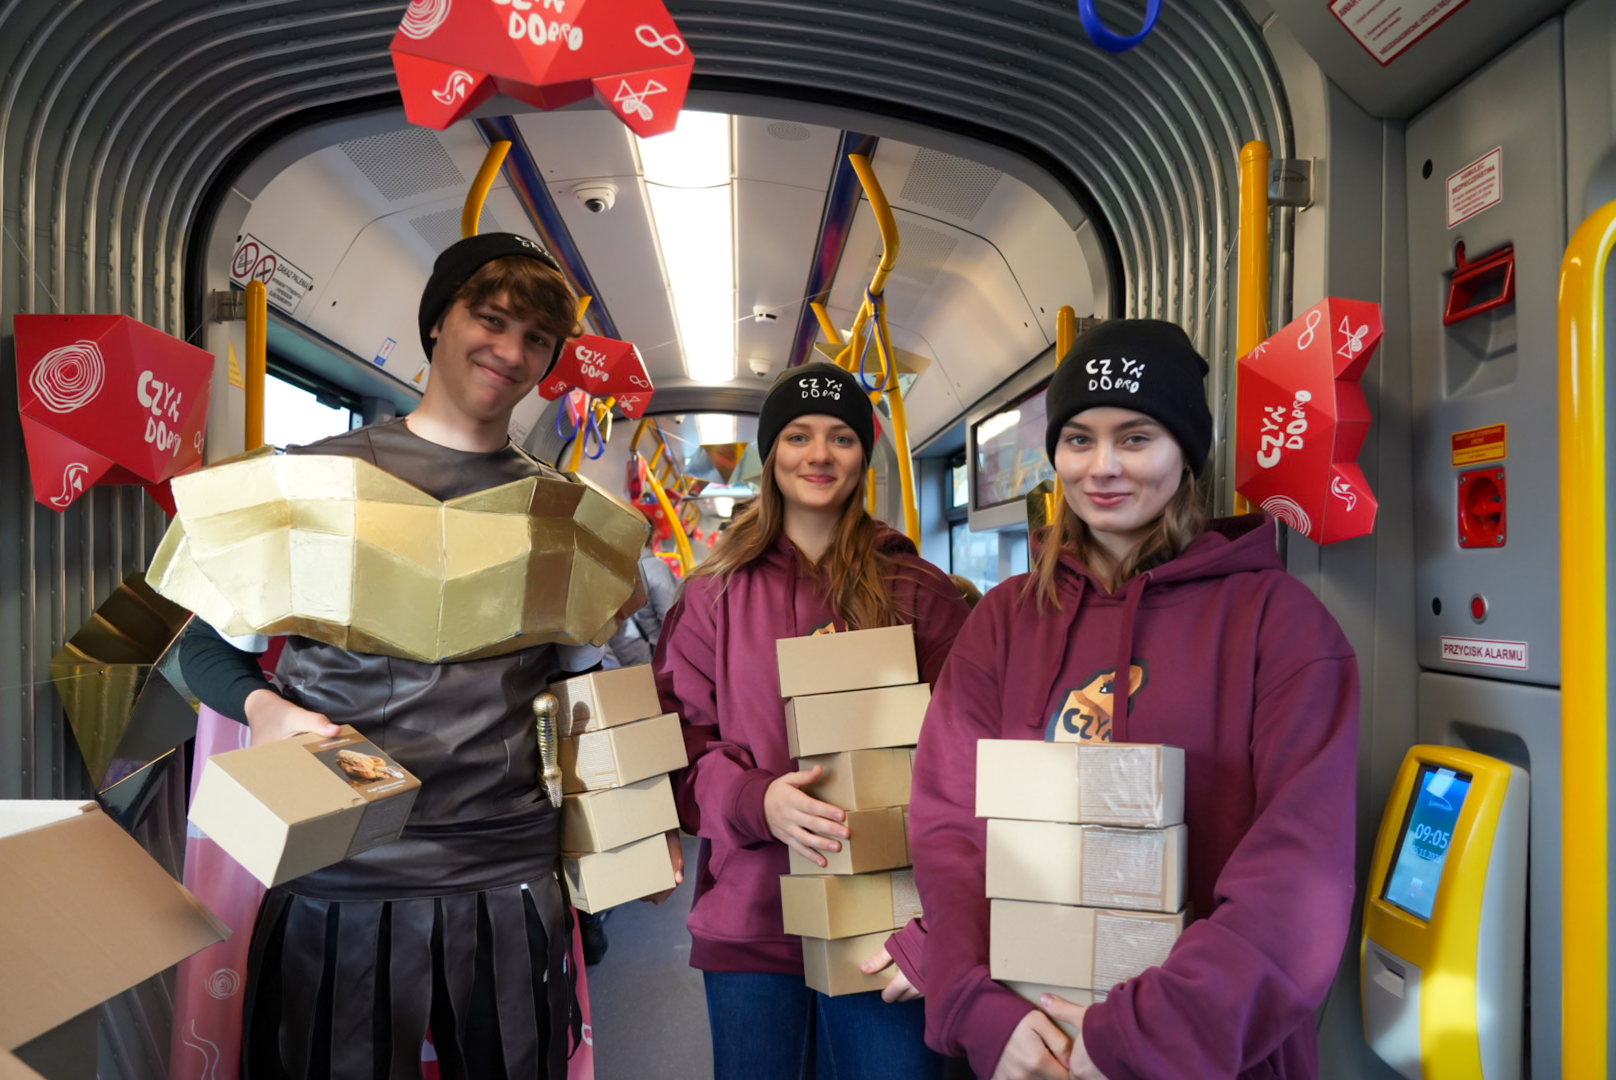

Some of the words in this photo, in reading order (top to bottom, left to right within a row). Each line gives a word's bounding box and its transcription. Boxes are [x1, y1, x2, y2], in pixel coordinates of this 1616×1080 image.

[508, 10, 583, 51] DOBRO
[277, 263, 293, 279] ZAKAZ
[1443, 643, 1483, 658] PRZYCISK
[1484, 647, 1523, 662] ALARMU
[1415, 823, 1450, 849] 09:05
